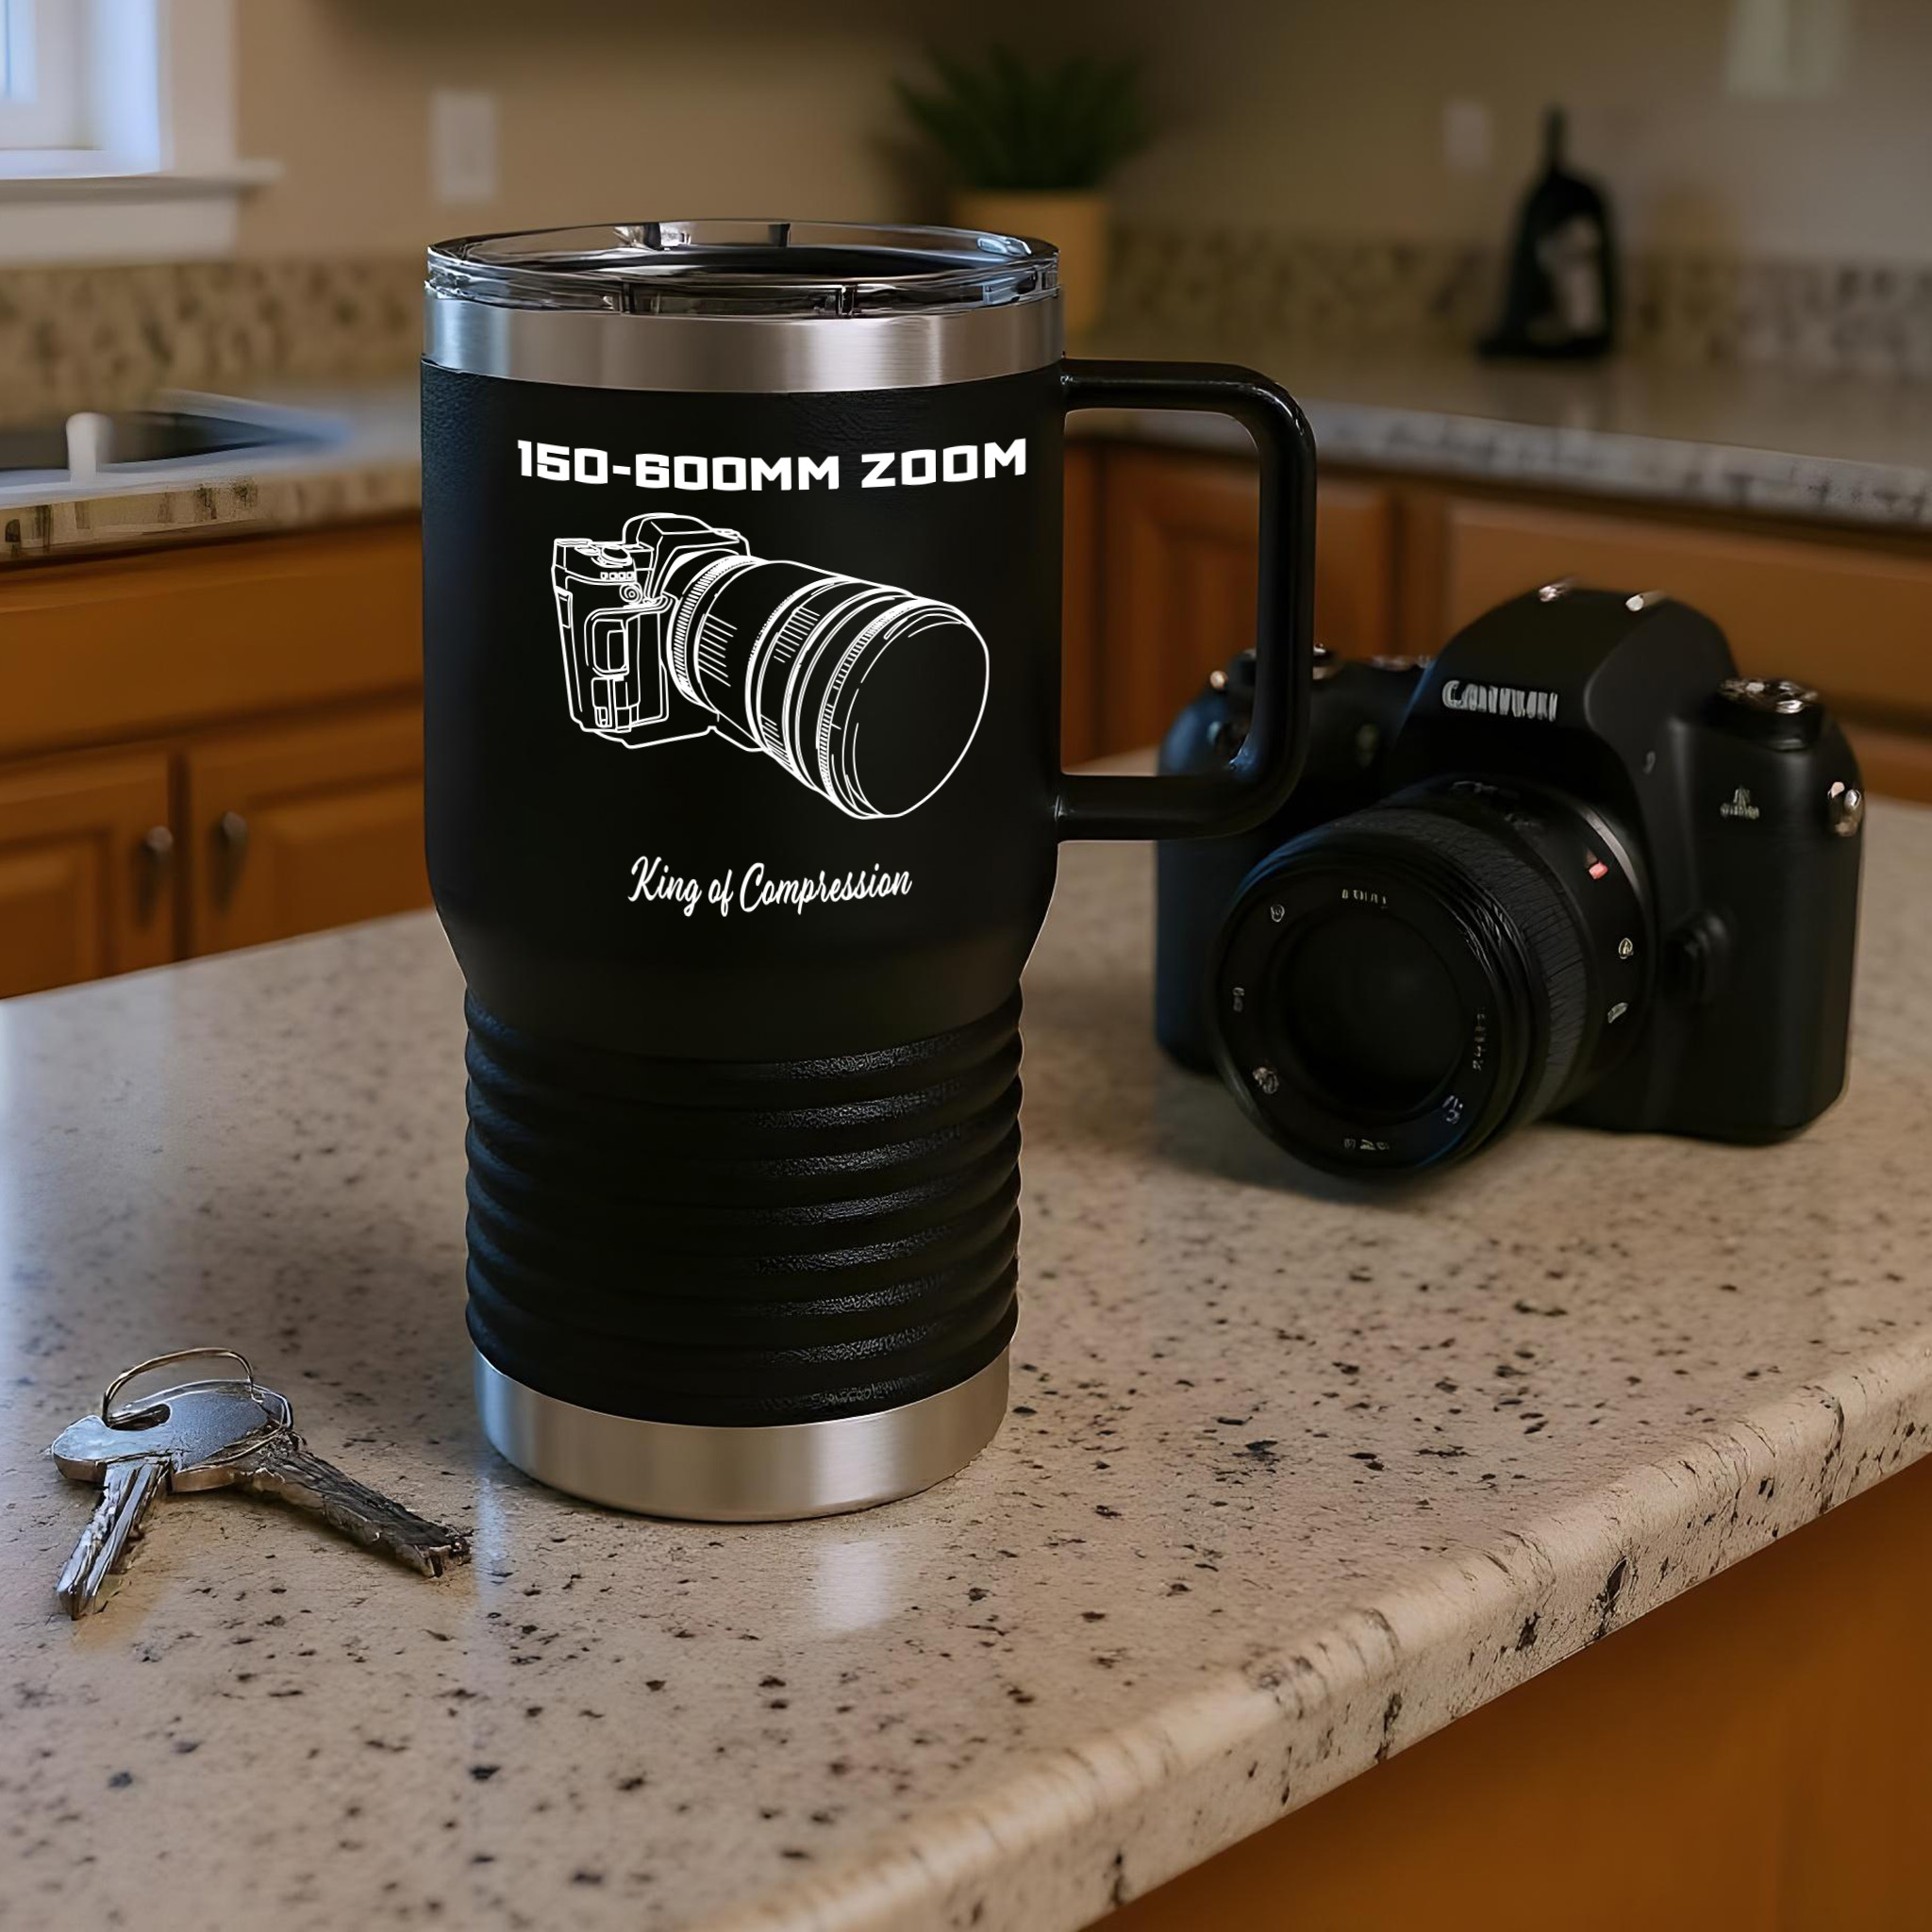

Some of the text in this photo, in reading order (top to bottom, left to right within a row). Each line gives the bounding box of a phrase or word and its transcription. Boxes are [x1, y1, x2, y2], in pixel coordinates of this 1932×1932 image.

[517, 438, 1026, 491] 150-600MM ZOOM
[627, 856, 913, 918] King of Compression
